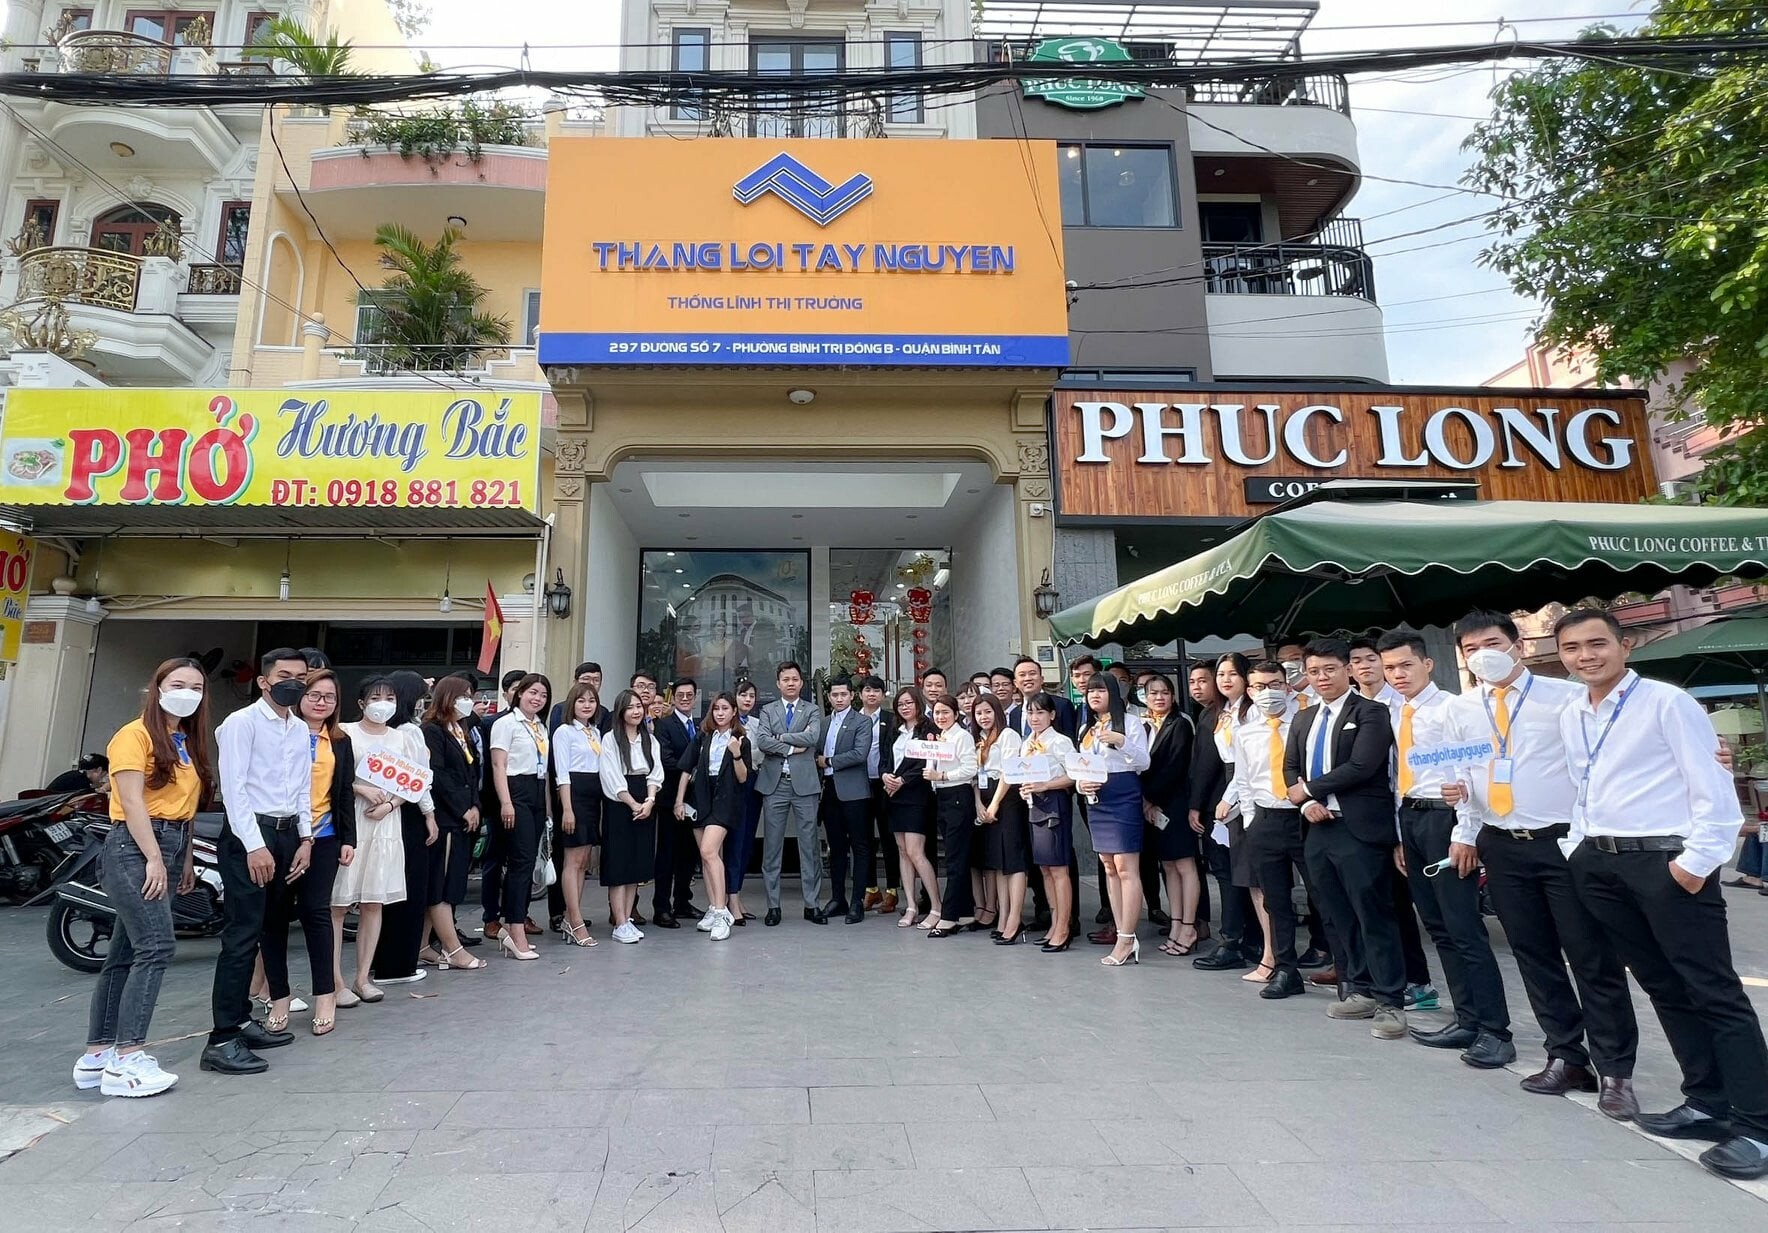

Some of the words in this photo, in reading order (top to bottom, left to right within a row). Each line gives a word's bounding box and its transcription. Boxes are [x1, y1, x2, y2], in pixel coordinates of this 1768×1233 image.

[592, 241, 722, 272] THANG
[730, 242, 785, 272] LOI
[793, 243, 865, 273] TAY
[874, 244, 1014, 274] NGUYEN
[667, 293, 724, 309] THỐNG
[765, 297, 791, 311] THỊ
[609, 342, 638, 353] 297
[690, 339, 710, 353] SỐ
[712, 342, 721, 353] 7
[789, 341, 820, 354] BÌNH
[821, 343, 842, 355] TRỊ
[883, 343, 894, 353] B
[902, 342, 940, 356] QUẬN
[941, 342, 972, 354] BÌNH
[973, 342, 1001, 354] TÂN
[1071, 401, 1348, 468] PHUC
[1369, 405, 1635, 471] LONG
[64, 395, 260, 504] PHỞ
[277, 399, 428, 473] Hương
[442, 398, 528, 459] Bắc
[271, 479, 317, 504] ĐT:
[328, 479, 397, 505] 0918
[407, 480, 458, 505] 881
[470, 480, 521, 505] 821
[1589, 536, 1631, 551] PHUC
[1634, 537, 1677, 552] LONG
[1680, 537, 1738, 552] COFFEE
[1741, 536, 1753, 551] &
[1159, 582, 1179, 599] LONG
[371, 760, 423, 792] 2022
